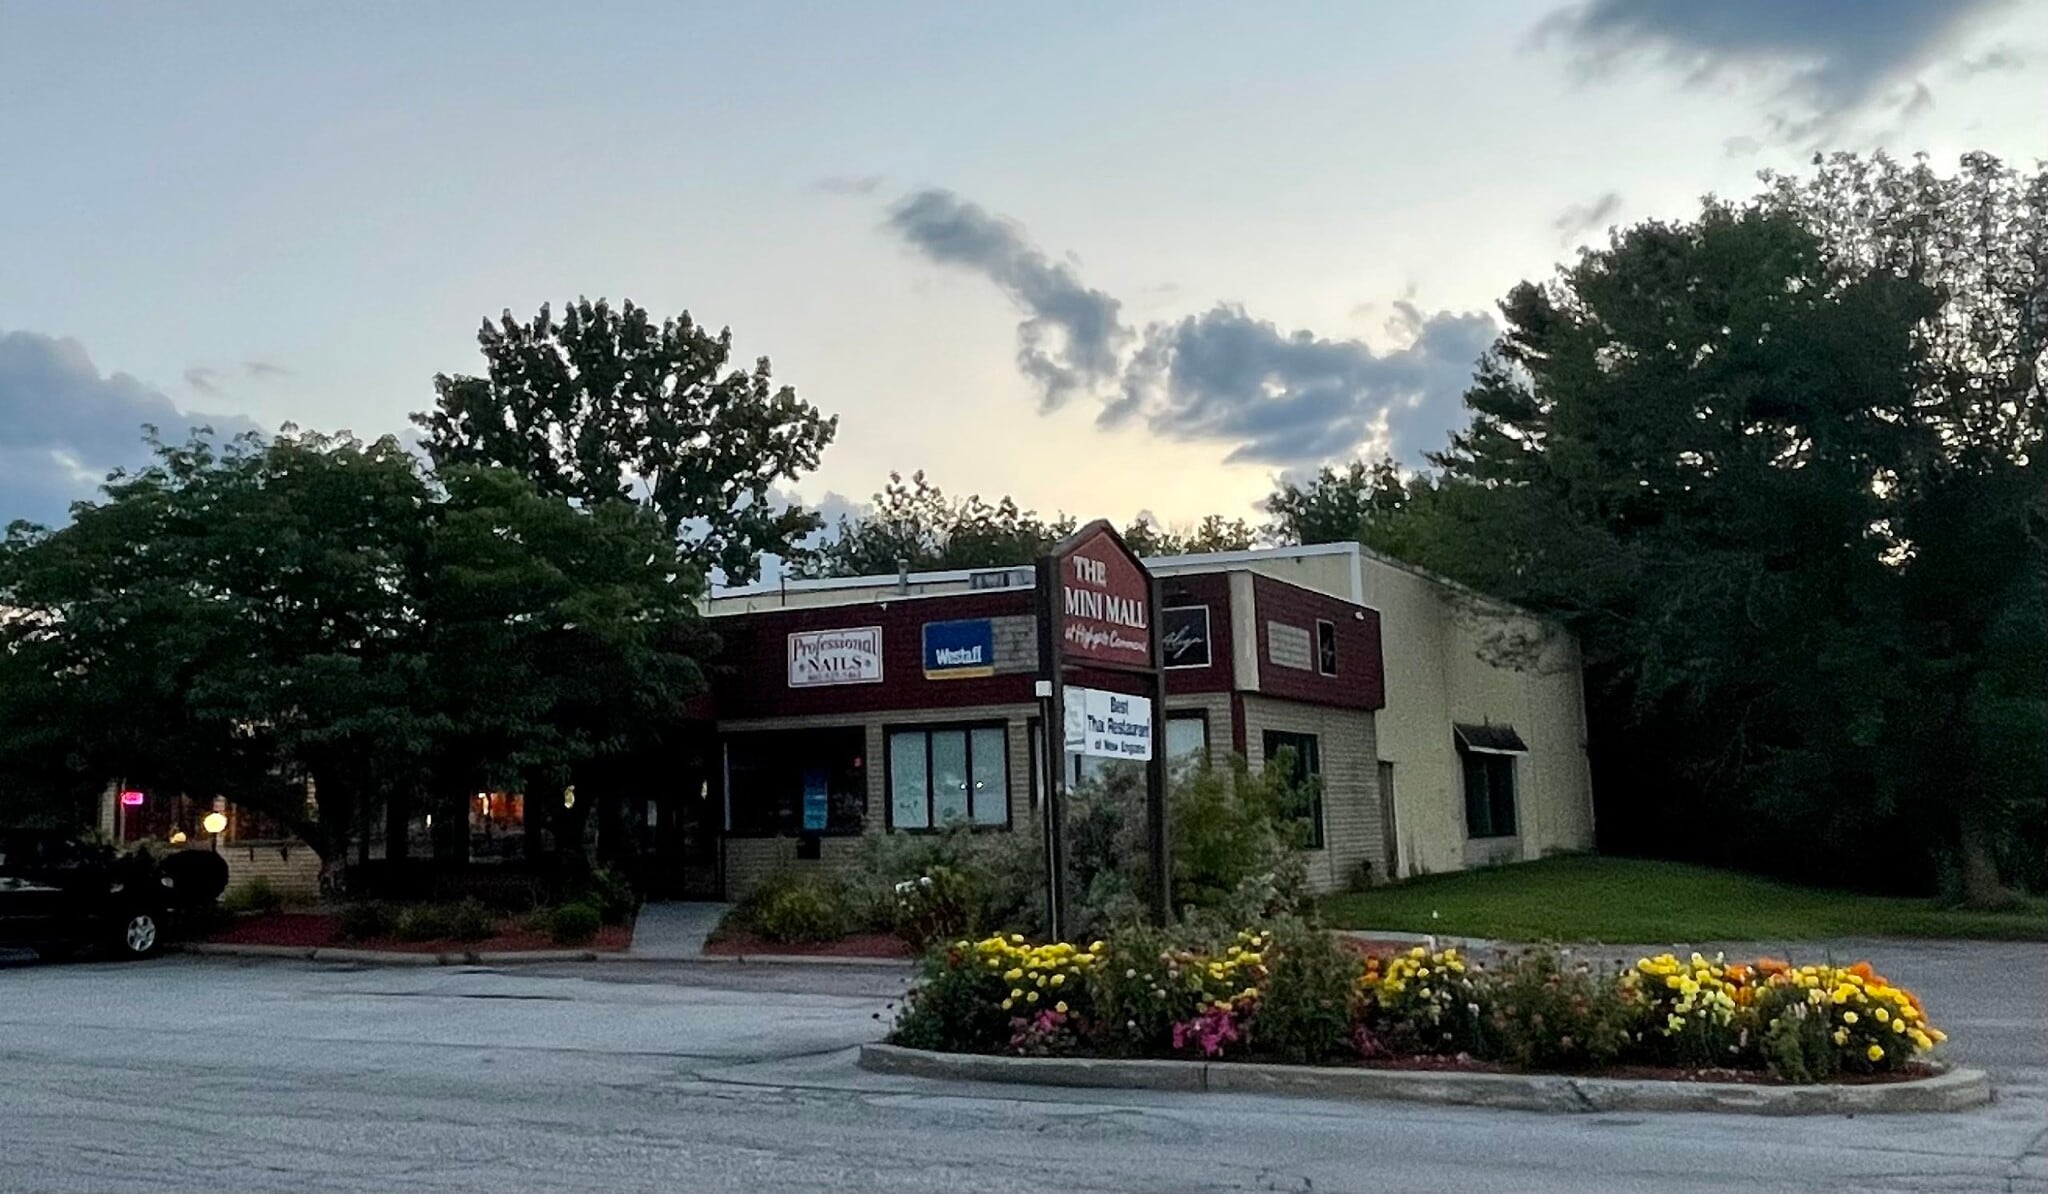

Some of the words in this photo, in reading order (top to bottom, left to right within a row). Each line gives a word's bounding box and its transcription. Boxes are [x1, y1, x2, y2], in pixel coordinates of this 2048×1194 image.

[1073, 555, 1107, 588] THE
[1063, 586, 1103, 620] MINI
[1105, 593, 1148, 629] MALL
[793, 632, 877, 662] Professional
[807, 656, 862, 672] NAILS
[1110, 696, 1129, 715] Best
[1087, 714, 1106, 733] Thai
[1107, 717, 1150, 738] Restaurant
